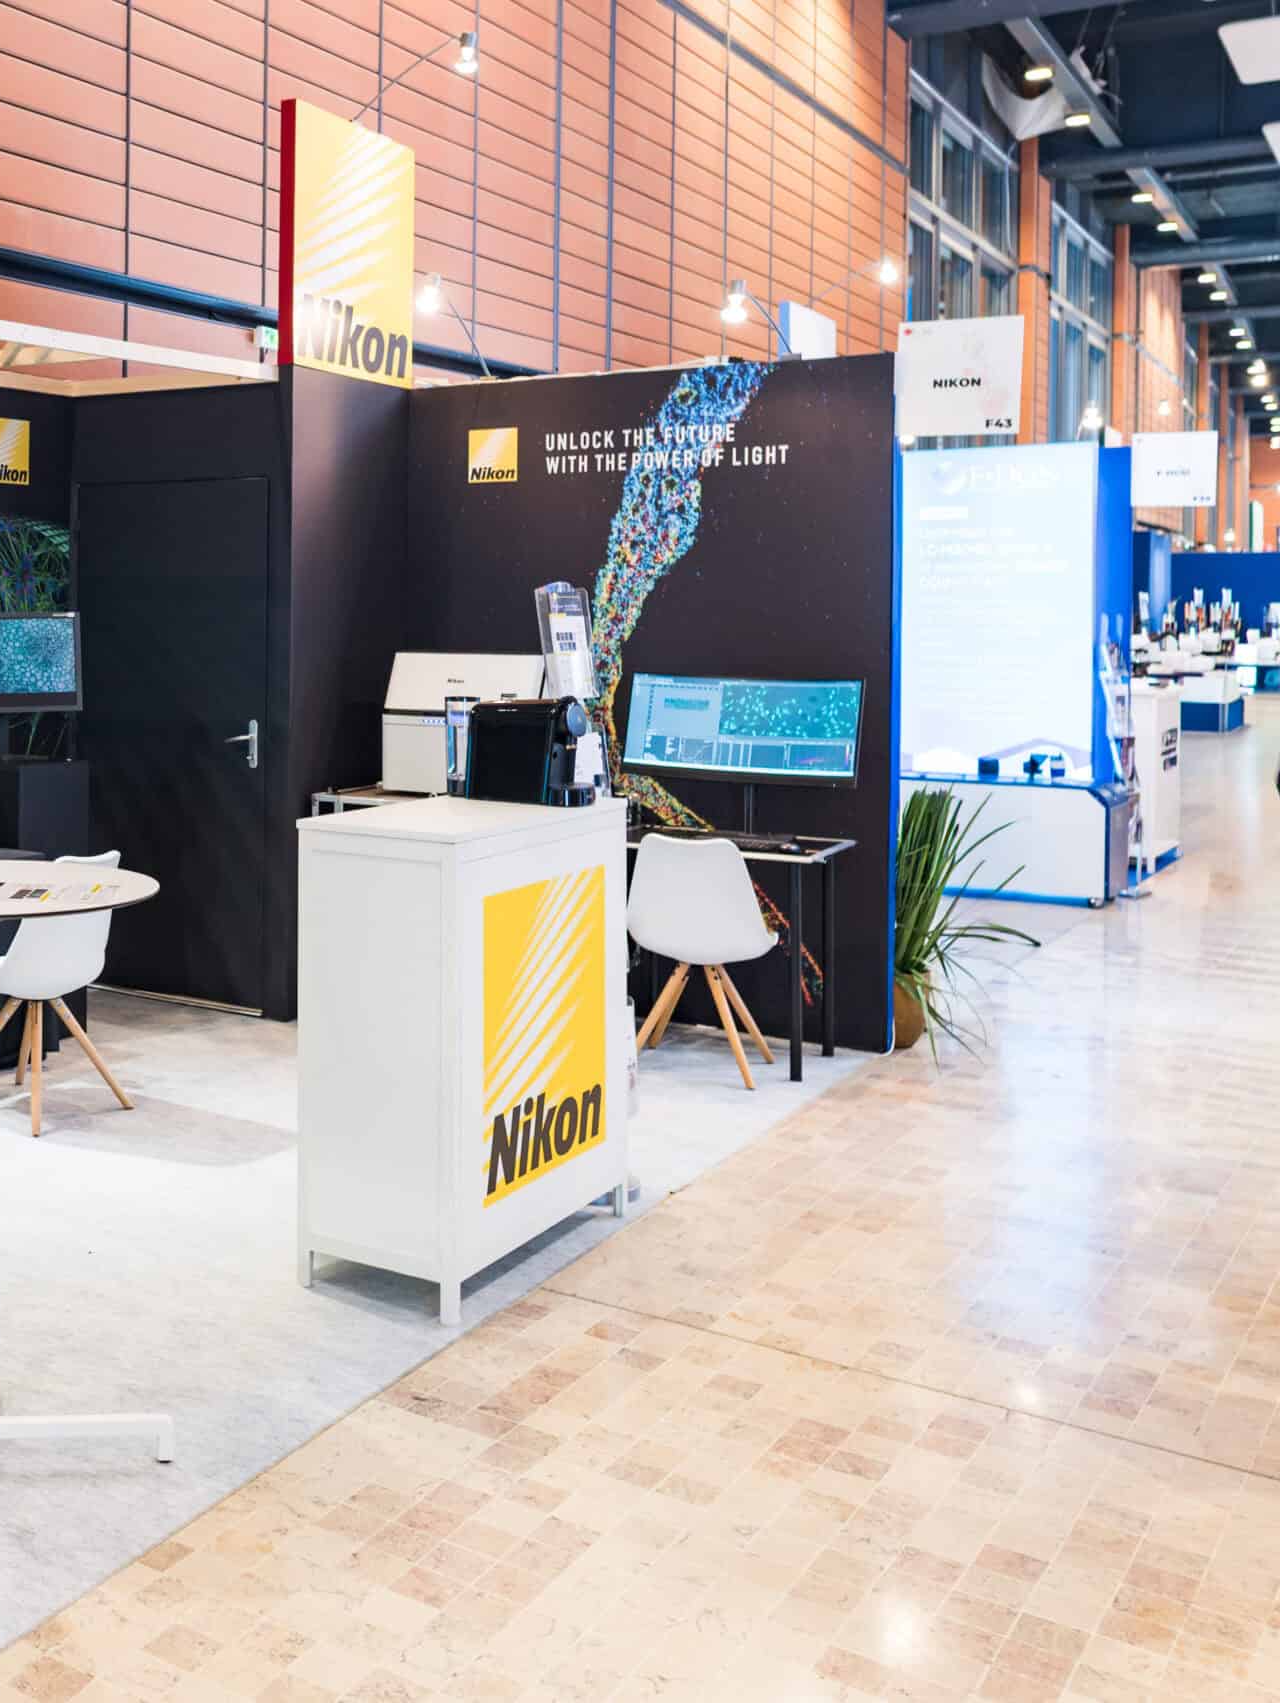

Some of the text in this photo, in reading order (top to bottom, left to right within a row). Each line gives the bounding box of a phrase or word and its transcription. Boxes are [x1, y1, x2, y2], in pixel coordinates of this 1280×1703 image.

[297, 293, 409, 379] Nikon
[932, 377, 982, 389] NIKON
[545, 422, 736, 452] UNLOCK THE FUTURE
[985, 418, 1012, 429] F43
[470, 466, 515, 481] Nikon
[545, 444, 790, 475] WITH THE POWER OF LIGHT
[486, 1083, 603, 1196] Nikon
